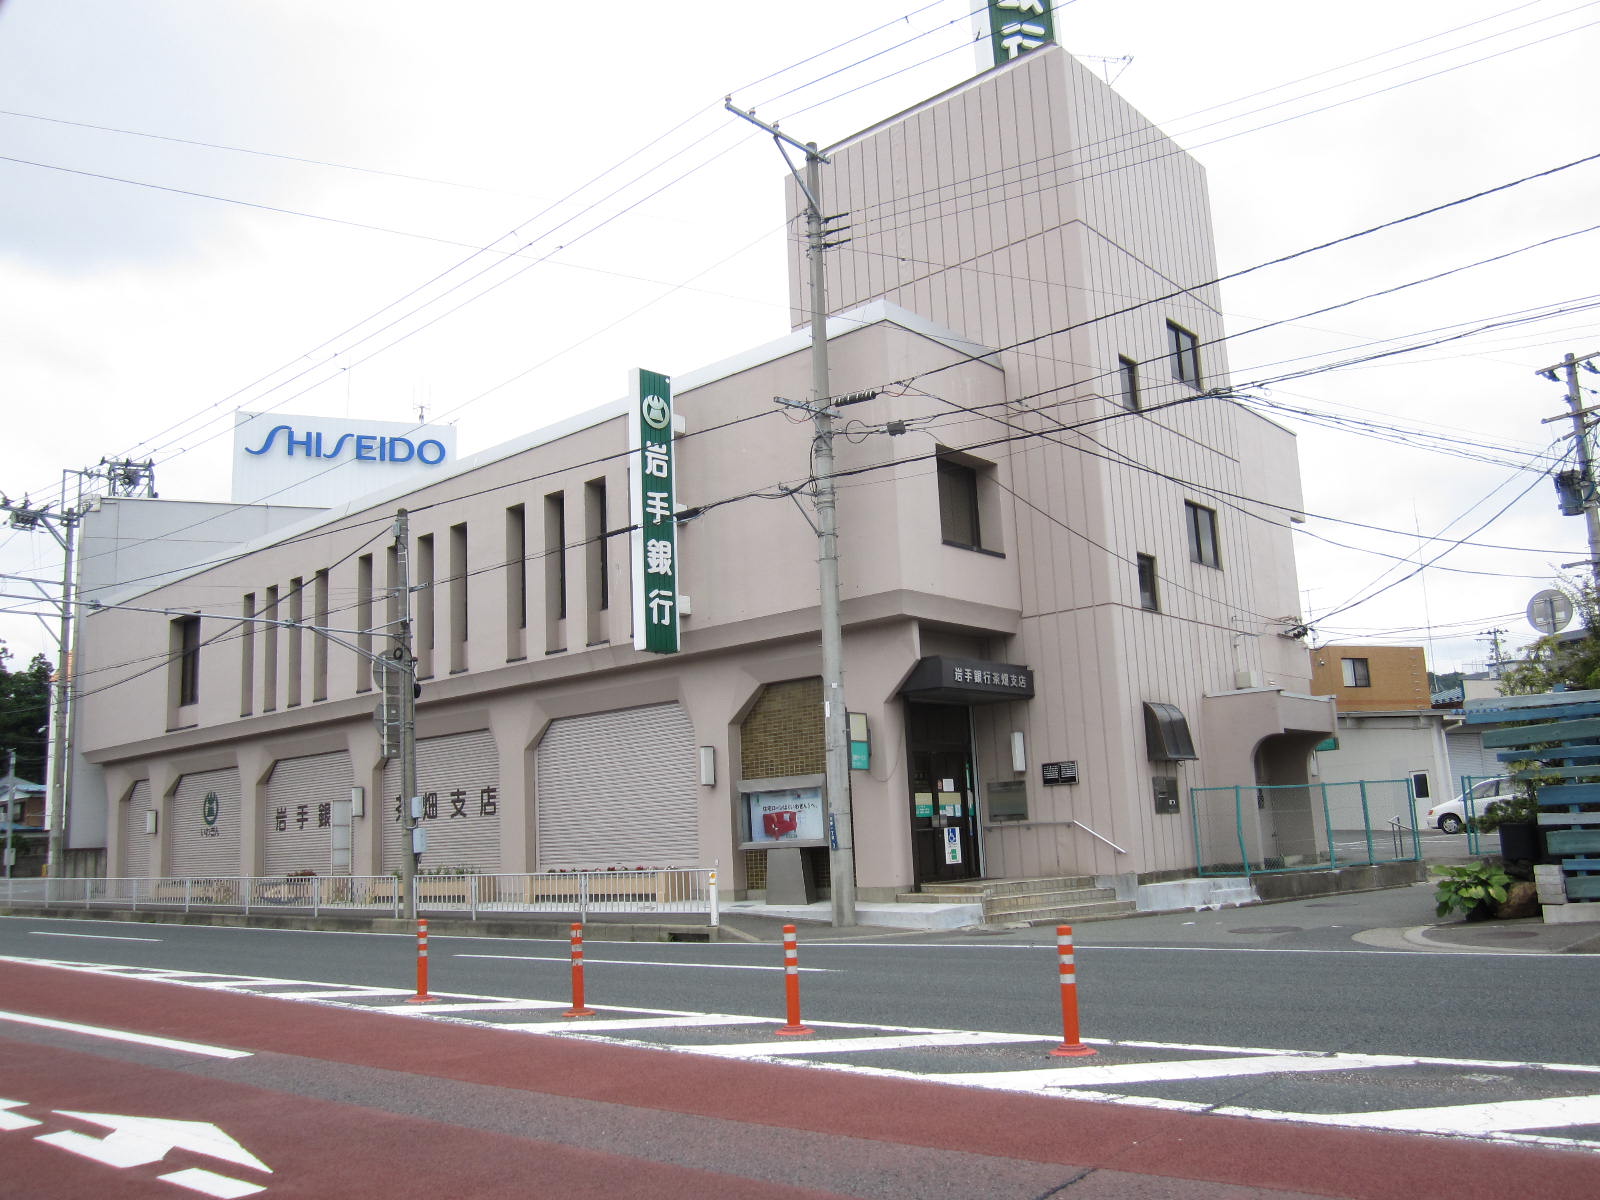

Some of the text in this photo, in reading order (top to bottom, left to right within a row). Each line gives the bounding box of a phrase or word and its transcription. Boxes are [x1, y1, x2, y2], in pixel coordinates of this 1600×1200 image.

[244, 424, 446, 465] SHISEIDO
[644, 440, 674, 626] 岩手銀行
[954, 667, 1027, 688] 岩手銀行茶畑支店
